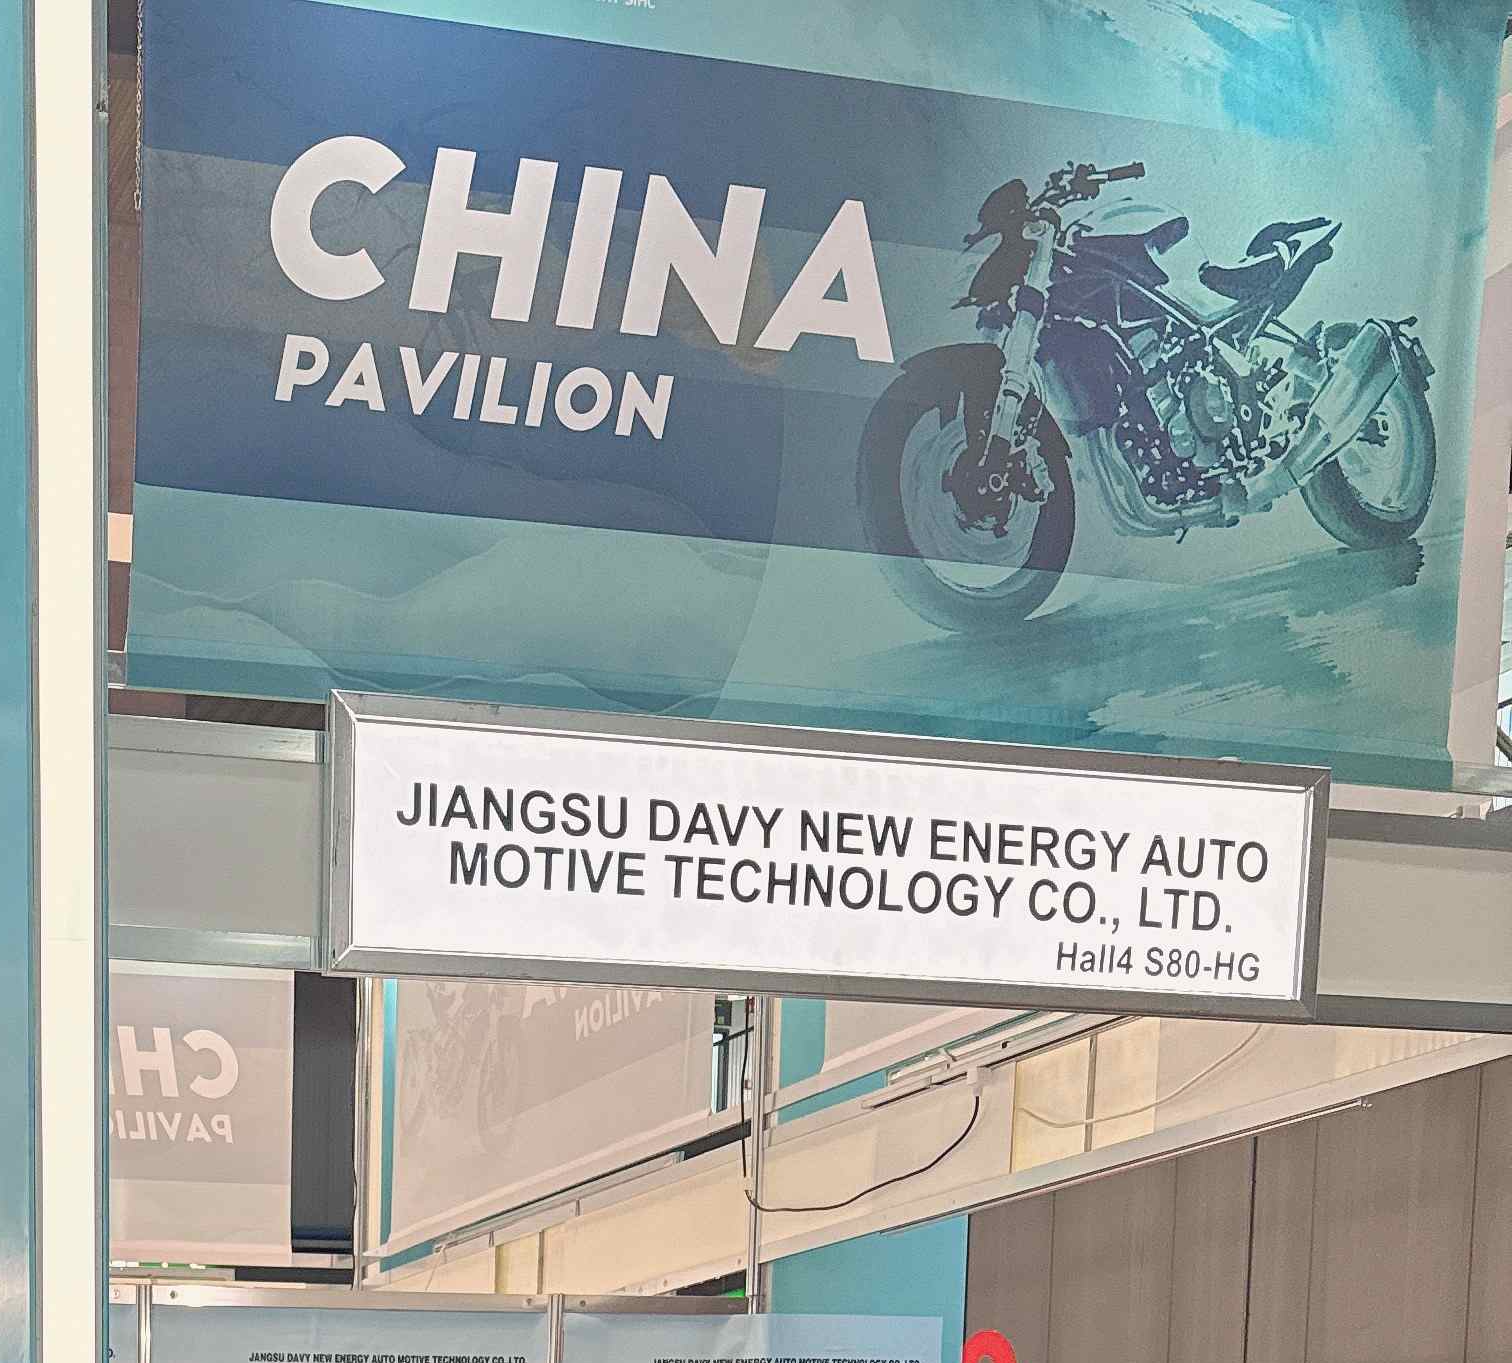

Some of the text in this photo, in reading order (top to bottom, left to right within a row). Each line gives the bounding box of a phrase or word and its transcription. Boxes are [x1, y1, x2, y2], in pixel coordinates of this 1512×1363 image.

[270, 135, 895, 364] CHINA
[274, 334, 674, 440] PAVILION
[396, 781, 1268, 884] JIANGSU DAVY NEW ENERGY AUTO
[449, 844, 1232, 934] MOTIVE TECHNOLOGY CO., LTD.
[1056, 942, 1261, 984] Hall4 S80-HG
[288, 1353, 311, 1363] DAVY
[313, 1353, 334, 1363] NEW
[335, 1354, 369, 1363] ENERGY
[372, 1354, 396, 1363] AUTO
